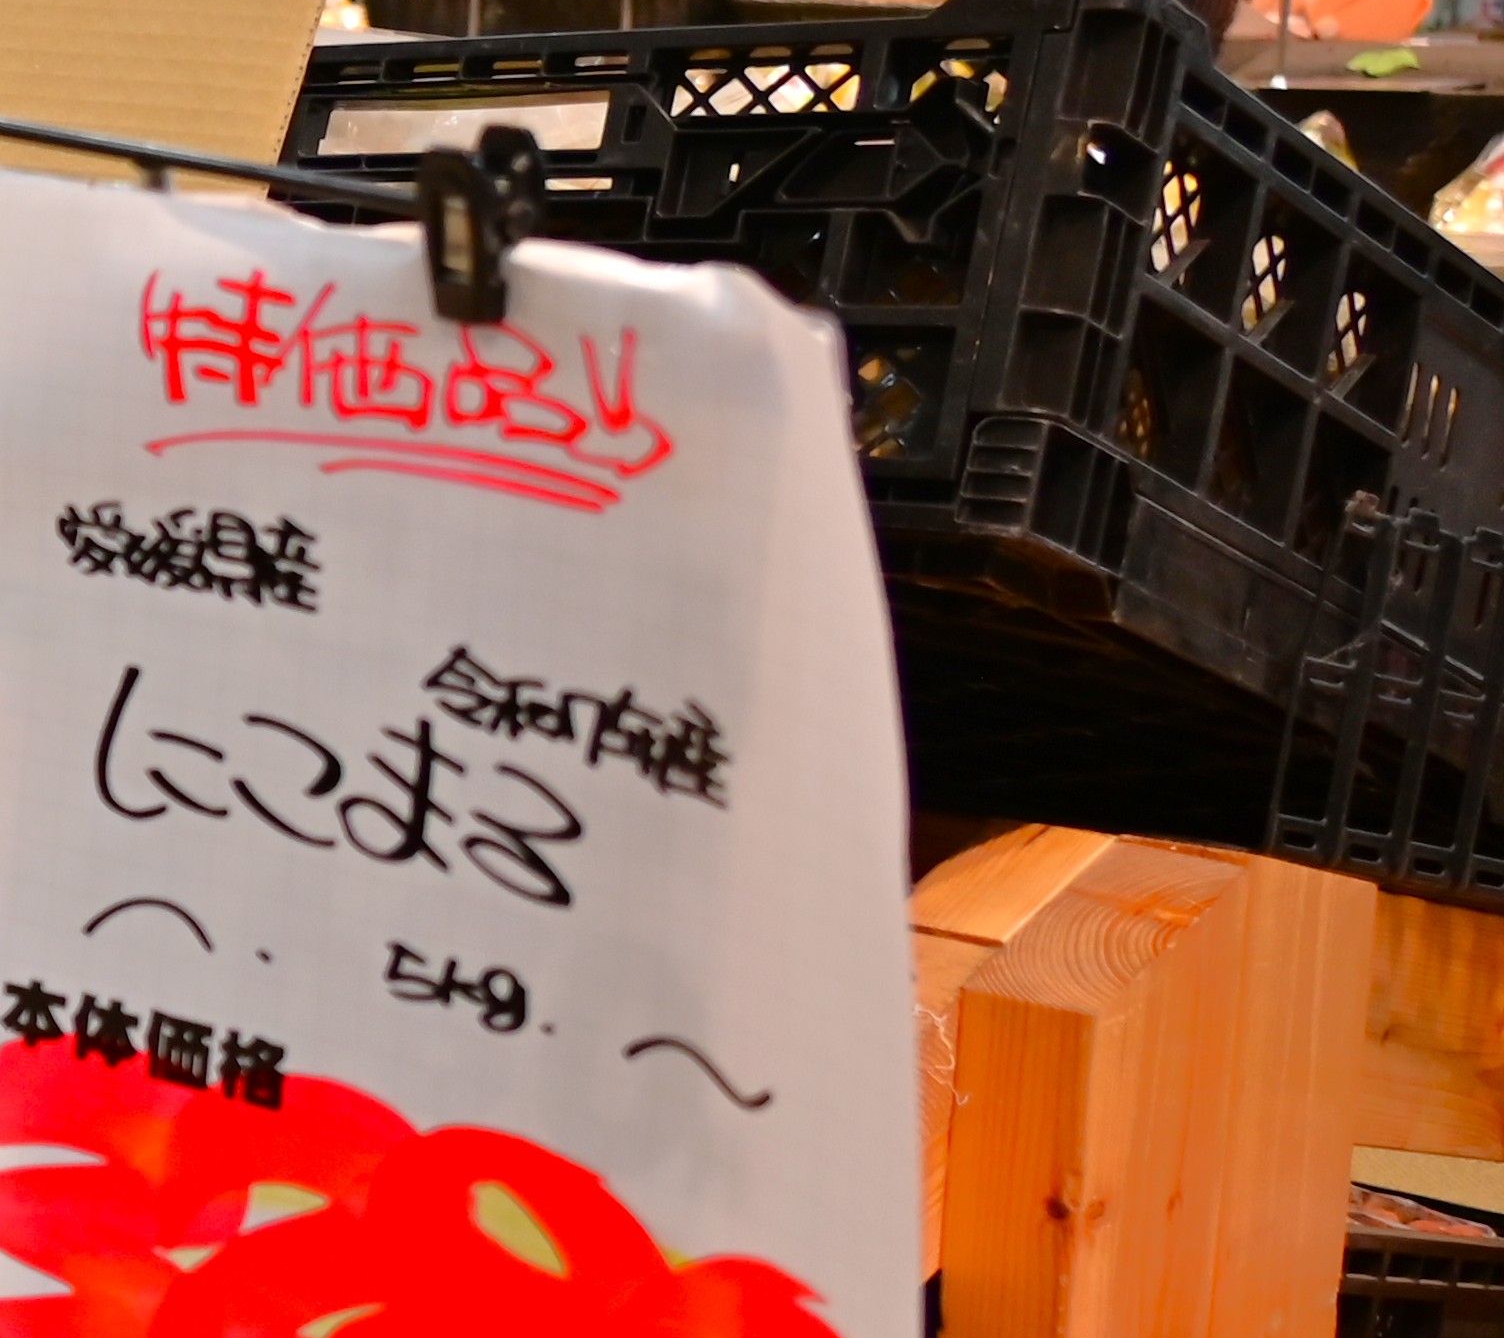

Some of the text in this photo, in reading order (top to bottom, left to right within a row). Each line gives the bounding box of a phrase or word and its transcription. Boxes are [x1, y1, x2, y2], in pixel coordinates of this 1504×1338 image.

[57, 499, 322, 615] 愛媛県産
[95, 665, 586, 909] にこまる
[0, 979, 290, 1112] 本体価格
